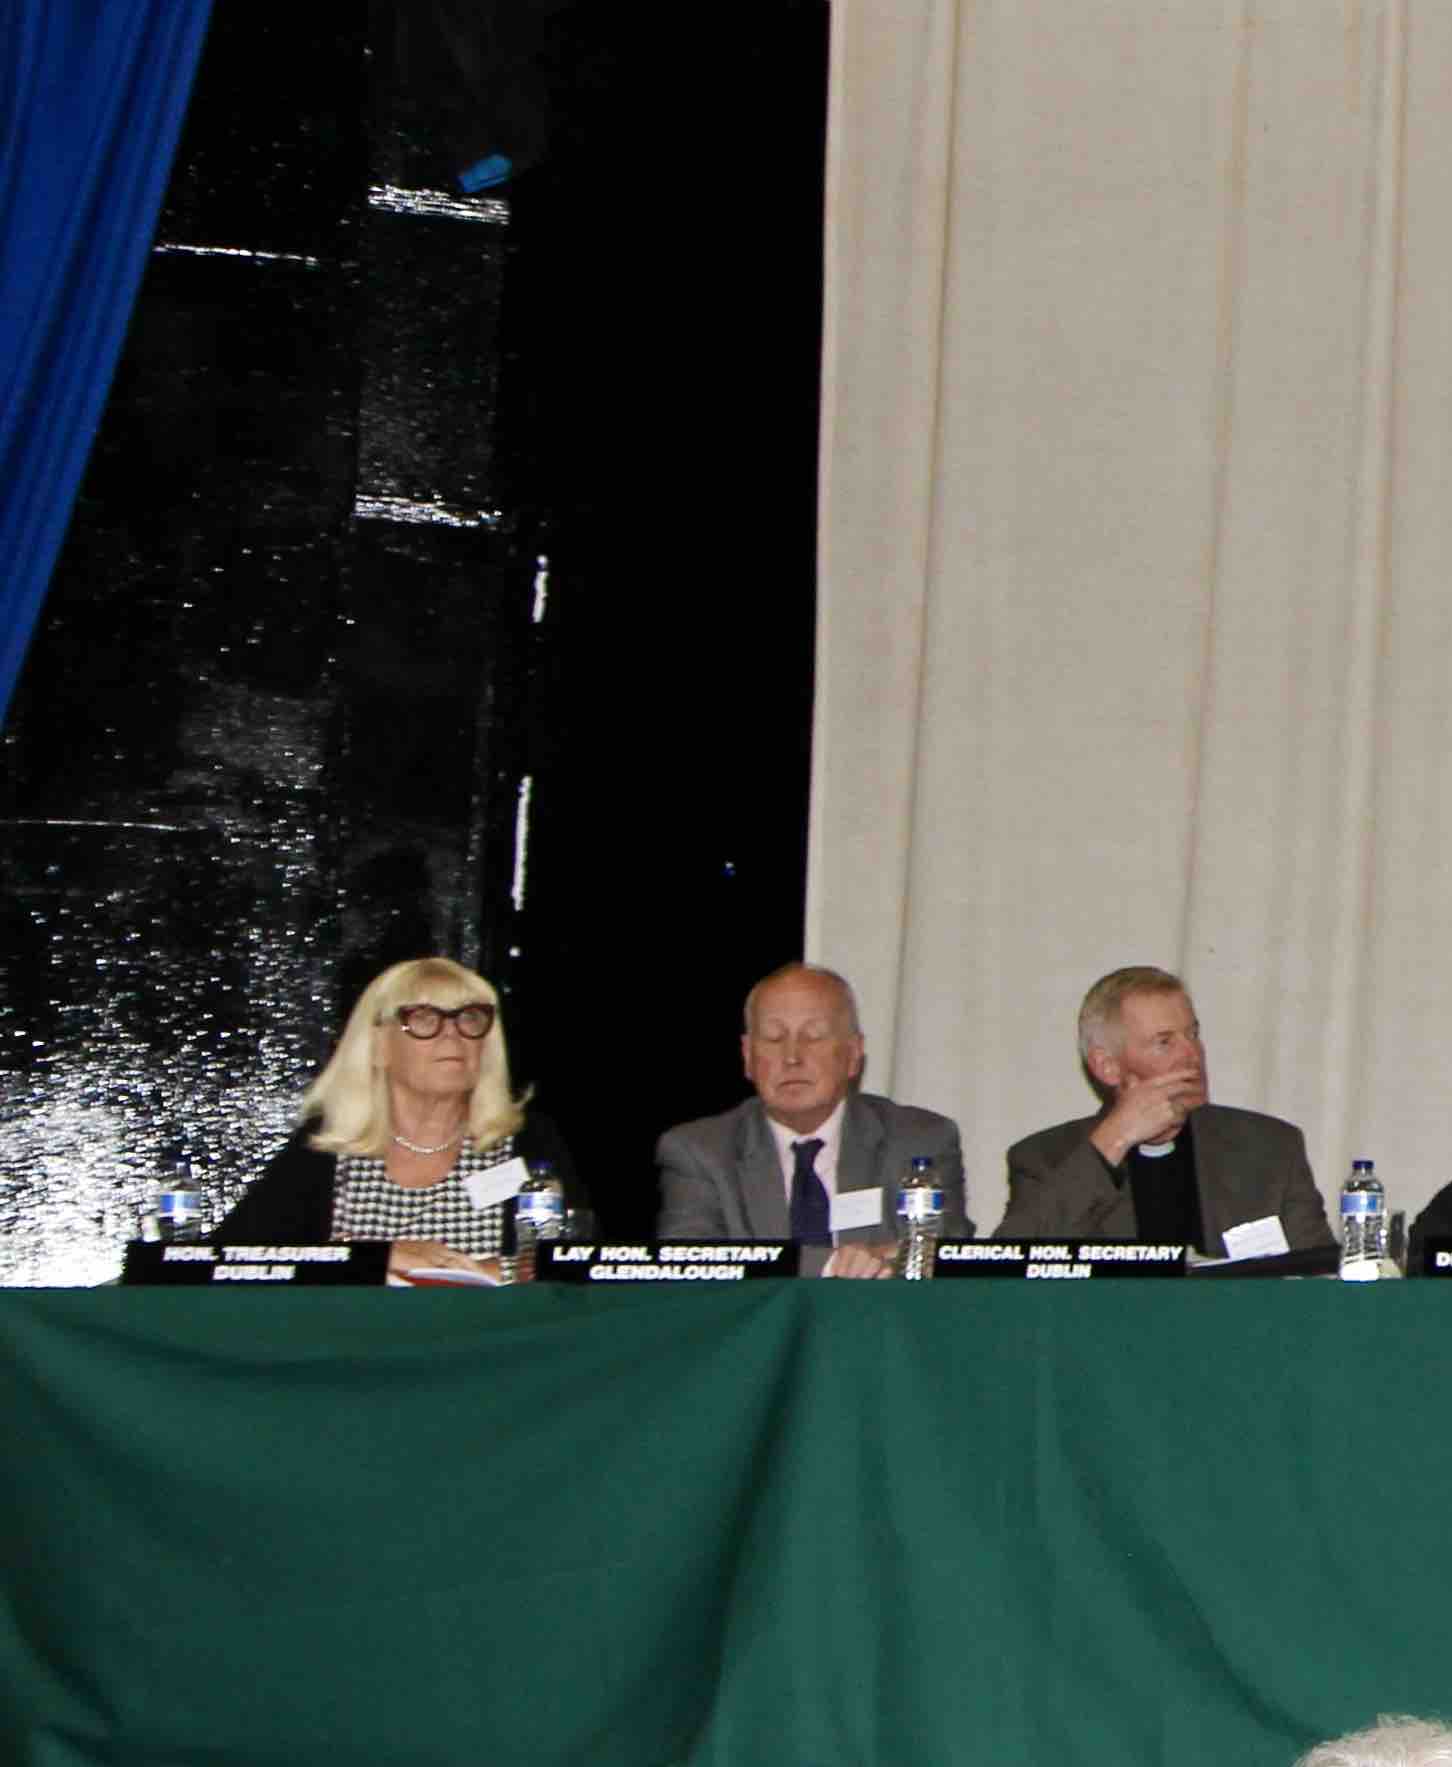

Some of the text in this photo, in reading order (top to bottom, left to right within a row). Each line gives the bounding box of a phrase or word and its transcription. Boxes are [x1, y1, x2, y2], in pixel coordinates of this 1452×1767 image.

[162, 1245, 351, 1262] HON. TREASURER
[552, 1245, 783, 1262] LAY HON. SECRETARY
[938, 1244, 1182, 1262] CLERICAL HON. SECRETARY
[212, 1264, 296, 1281] DUBLIN
[589, 1264, 745, 1281] GLENDALOUGH
[1025, 1263, 1092, 1279] DUBLIN
